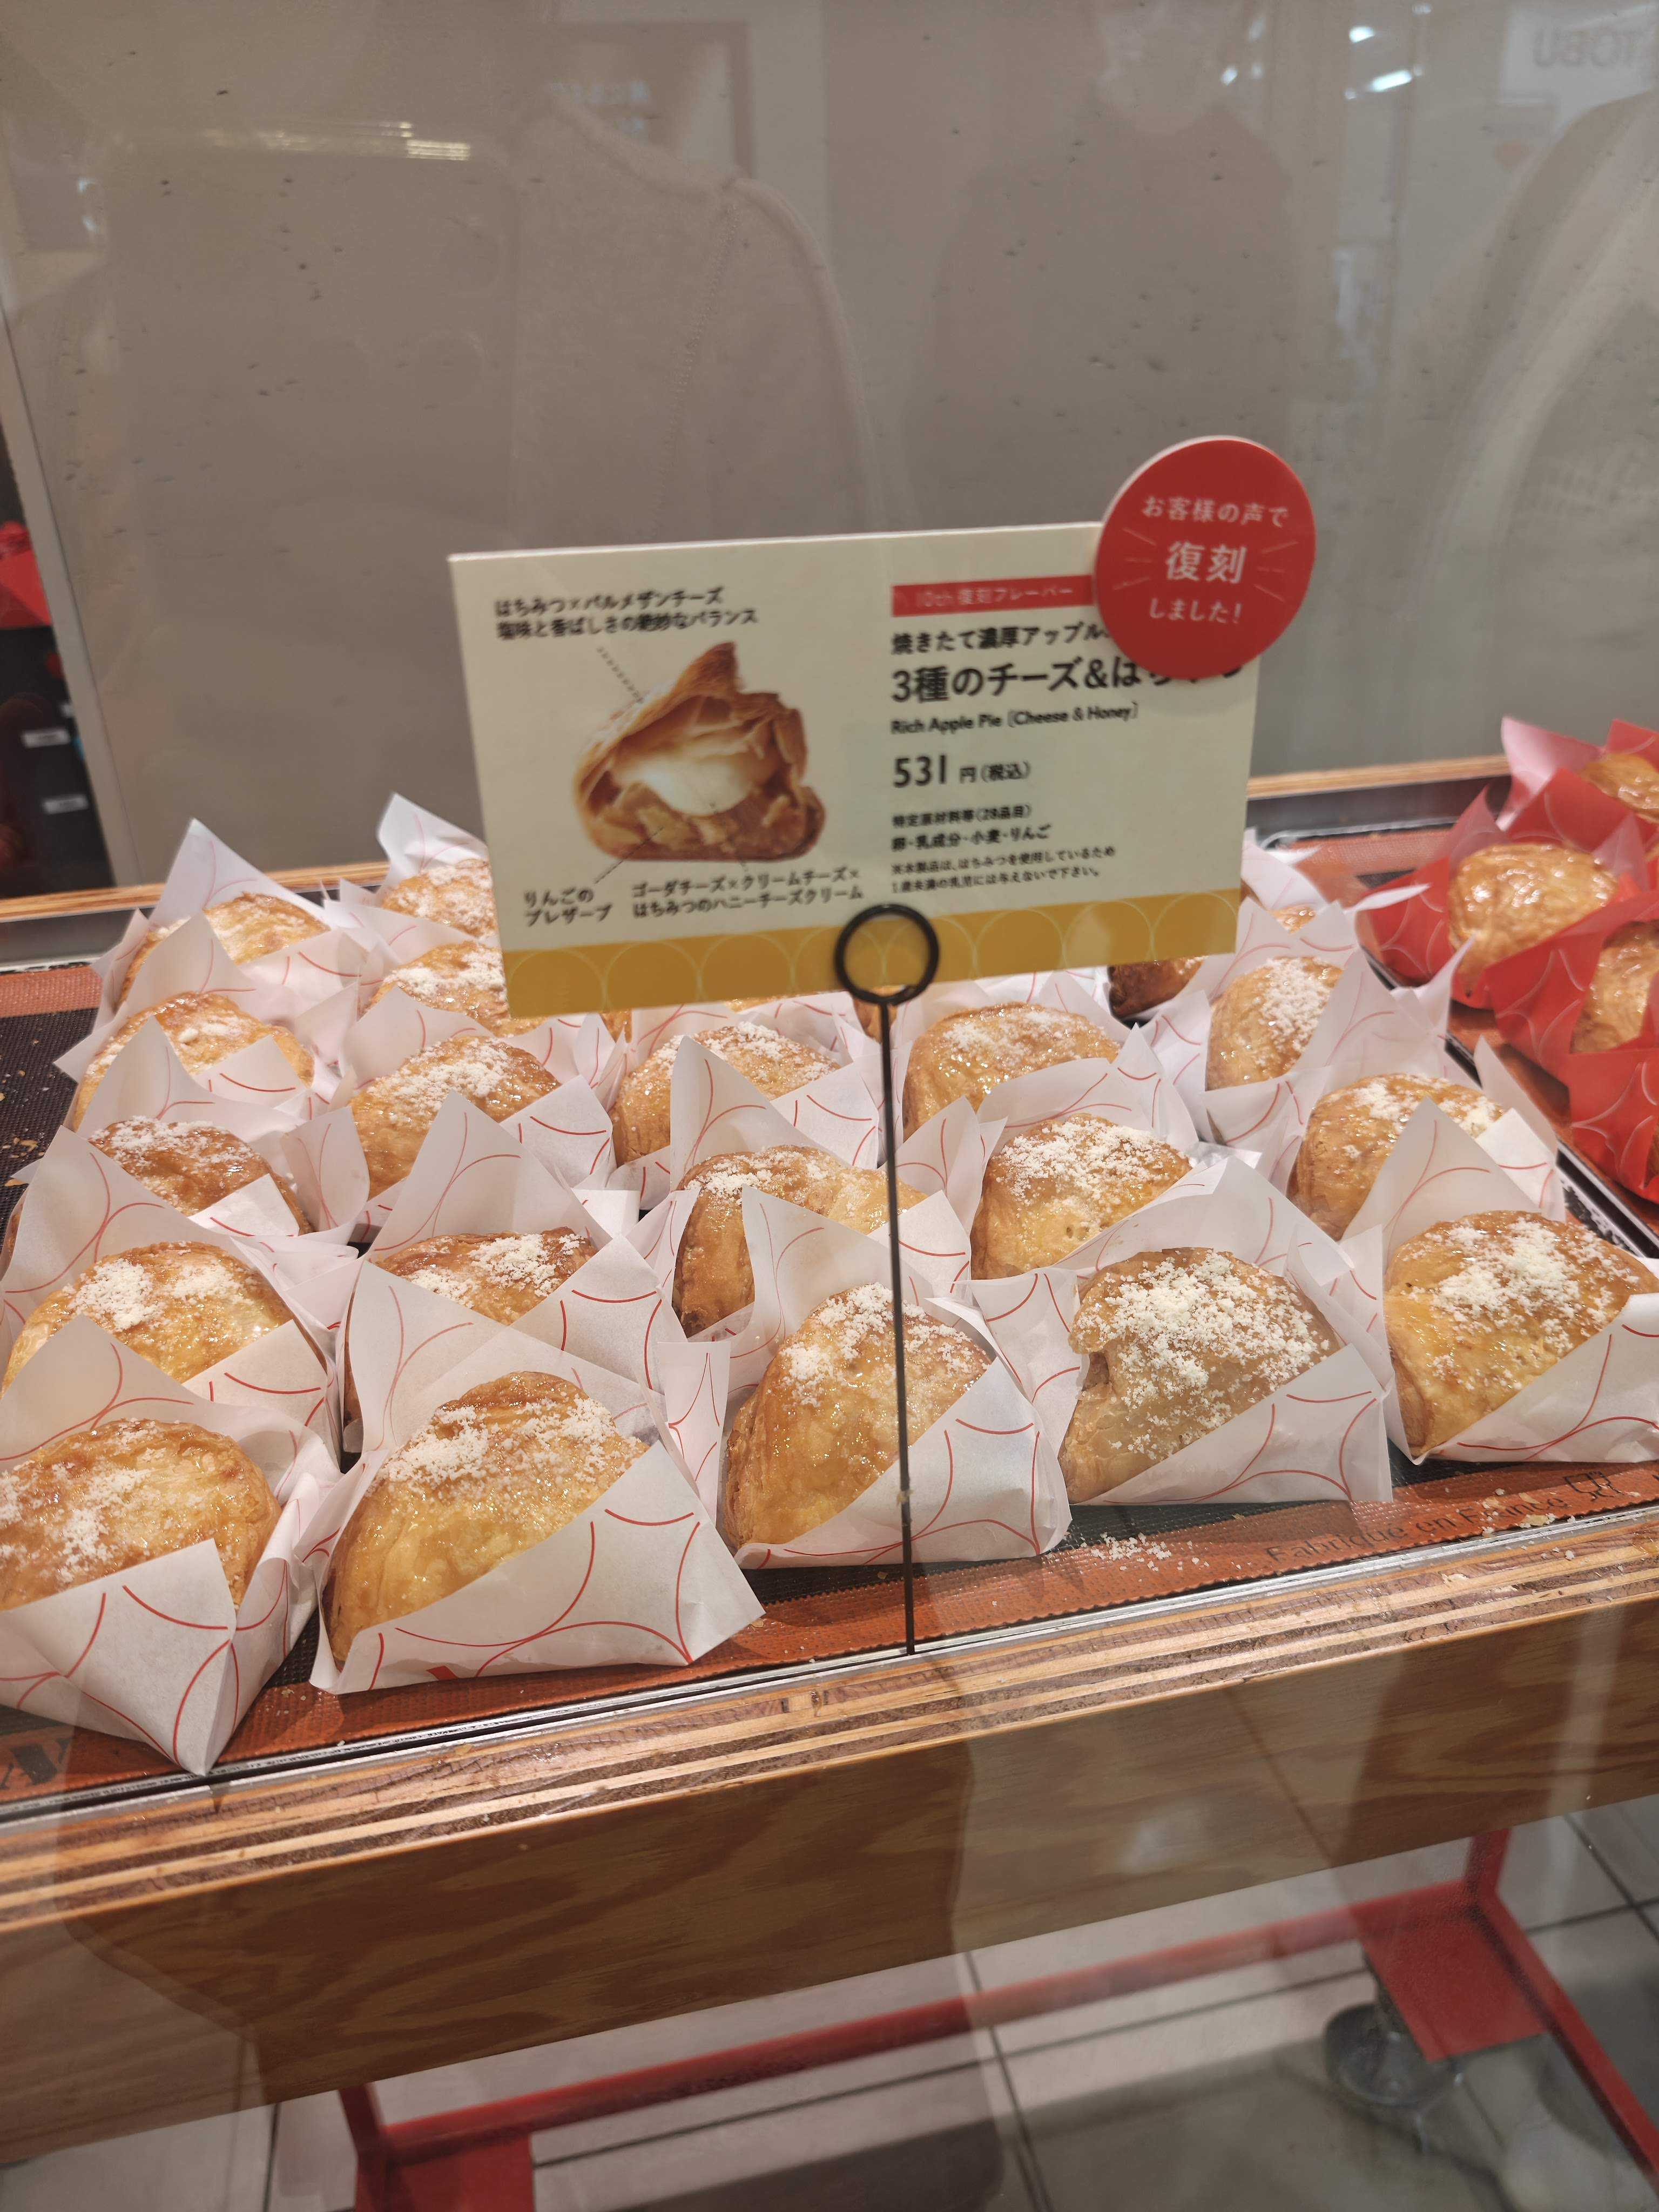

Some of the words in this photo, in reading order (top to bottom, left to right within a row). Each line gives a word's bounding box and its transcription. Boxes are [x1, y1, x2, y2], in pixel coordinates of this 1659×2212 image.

[1142, 496, 1289, 528] お客様の声で
[1166, 541, 1248, 584] 復刻
[891, 719, 923, 733] Rich
[928, 716, 974, 734] Apple
[979, 713, 1002, 727] Pie
[1073, 707, 1083, 721] &
[893, 755, 947, 787] 531
[524, 888, 594, 906] りんごの
[633, 885, 862, 918] はちみつのハニーチーズクリーム
[1415, 1518, 1456, 1534] en
